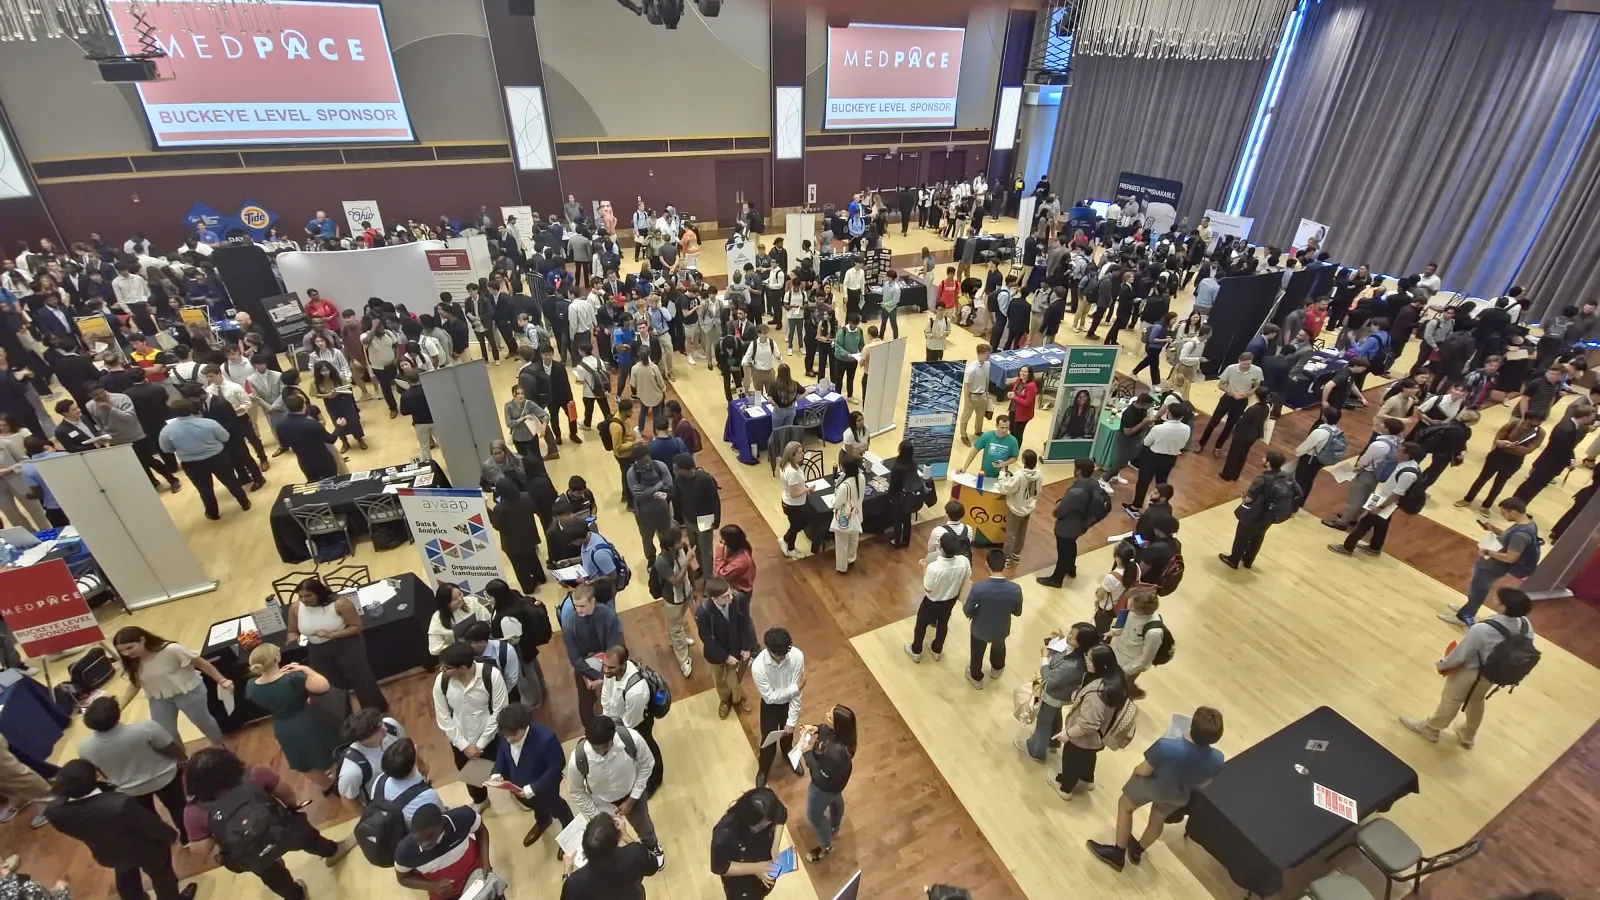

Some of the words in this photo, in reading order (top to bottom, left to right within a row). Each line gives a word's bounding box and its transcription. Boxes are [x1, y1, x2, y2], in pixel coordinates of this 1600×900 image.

[155, 30, 366, 61] MEDPACE
[844, 46, 949, 68] MEDPACE
[831, 103, 876, 113] BUCKEYE
[879, 102, 907, 112] LEVEL
[910, 102, 951, 112] SPONSOR
[159, 109, 249, 124] BUCKEYE
[254, 109, 311, 122] LEVEL
[316, 108, 398, 122] SPONSOR
[1119, 182, 1141, 192] PREPARED
[243, 212, 267, 225] Tide
[348, 210, 374, 222] Ohio
[915, 416, 946, 424] innovate
[423, 499, 468, 512] avaap
[1, 591, 81, 616] MEDPACE
[16, 623, 60, 638] BUCKEYE
[63, 615, 93, 626] LEVEL
[33, 625, 80, 639] SPONSOR
